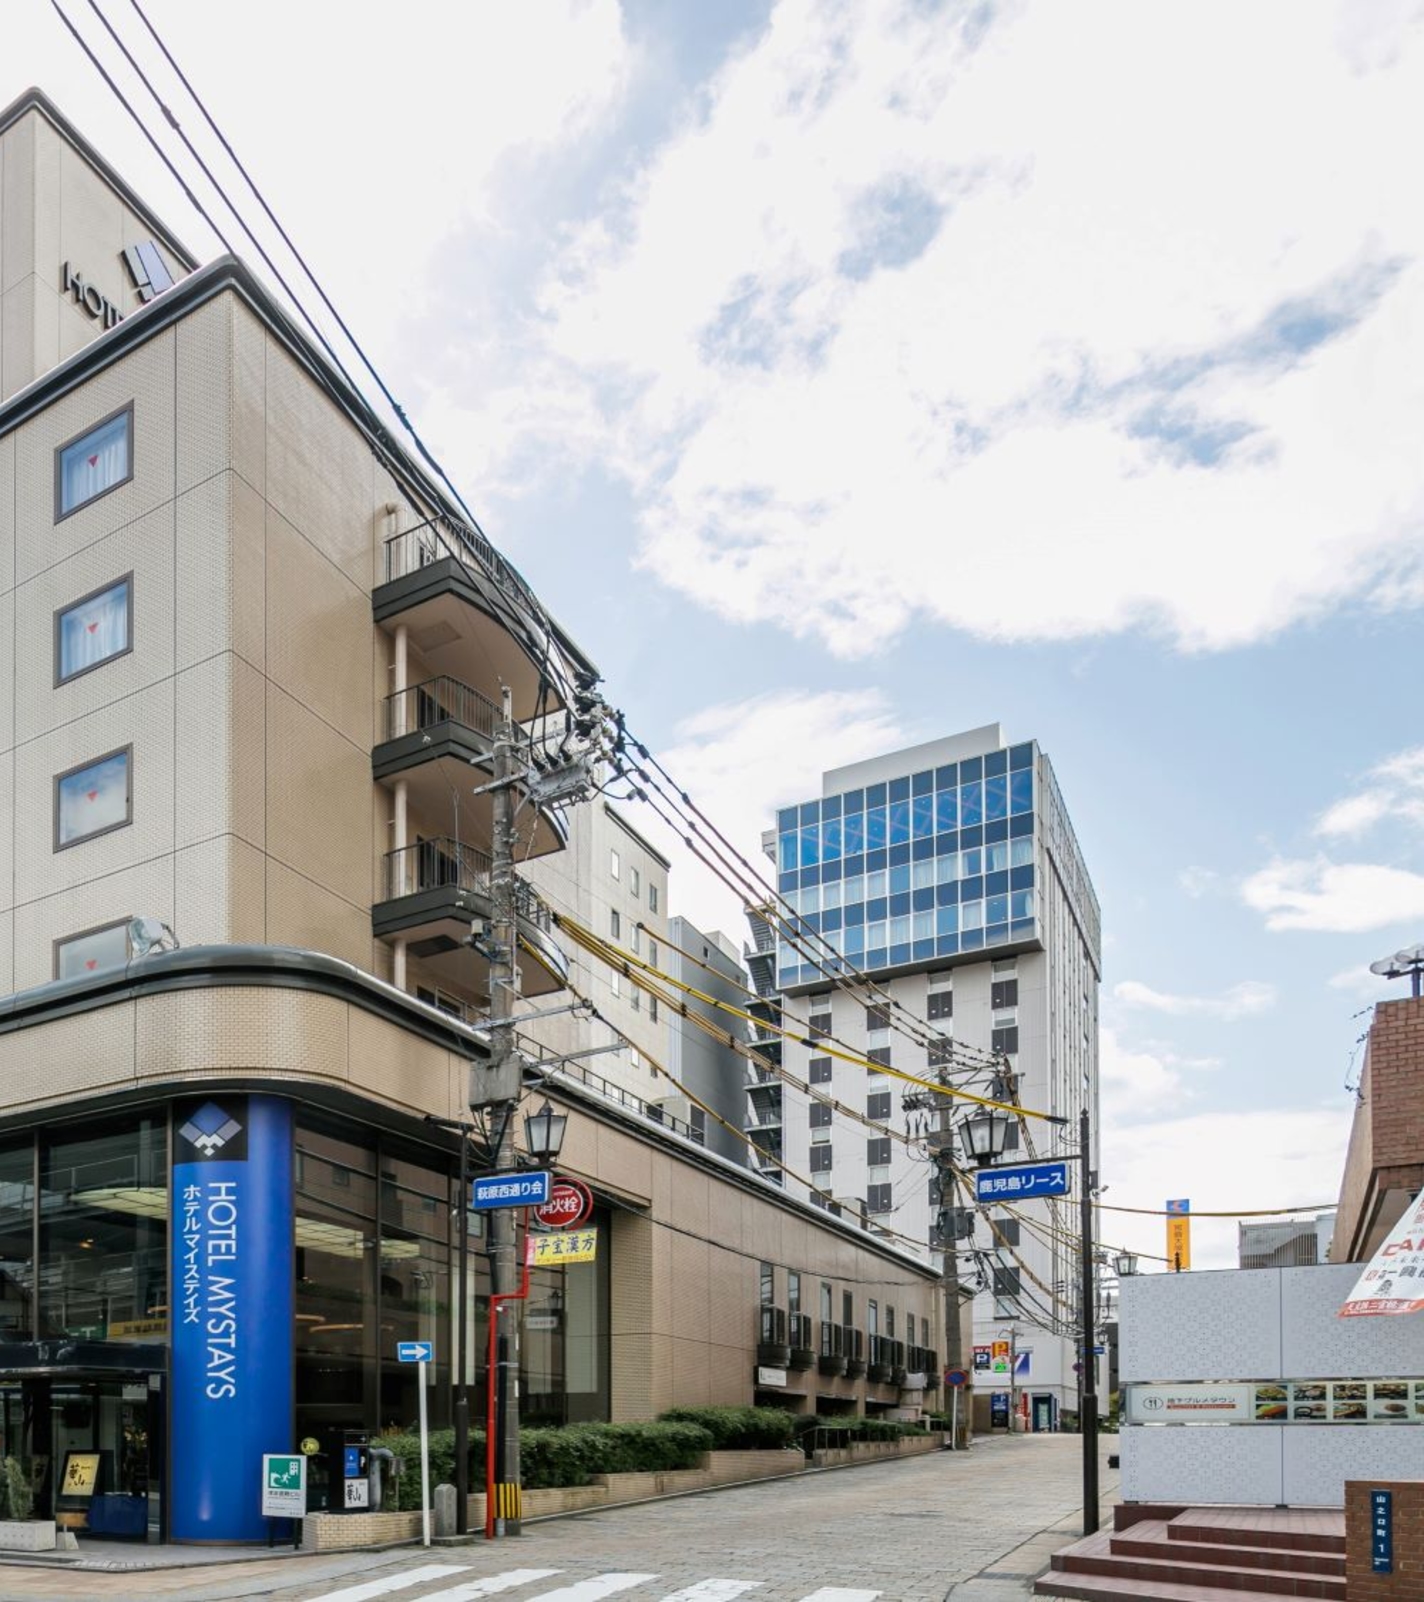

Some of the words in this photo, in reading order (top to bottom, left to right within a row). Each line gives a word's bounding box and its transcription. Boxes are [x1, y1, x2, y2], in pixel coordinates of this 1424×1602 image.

[979, 1172, 1064, 1193] 鹿児島リース
[540, 1196, 578, 1215] 消火栓
[207, 1182, 237, 1266] HOTEL
[183, 1184, 202, 1323] ホテルマイステイズ
[537, 1235, 594, 1255] 子宝漢方
[206, 1275, 236, 1399] MYSTAYS
[976, 1354, 988, 1364] P
[1376, 1495, 1387, 1537] 山之口町
[1378, 1544, 1384, 1553] 1
